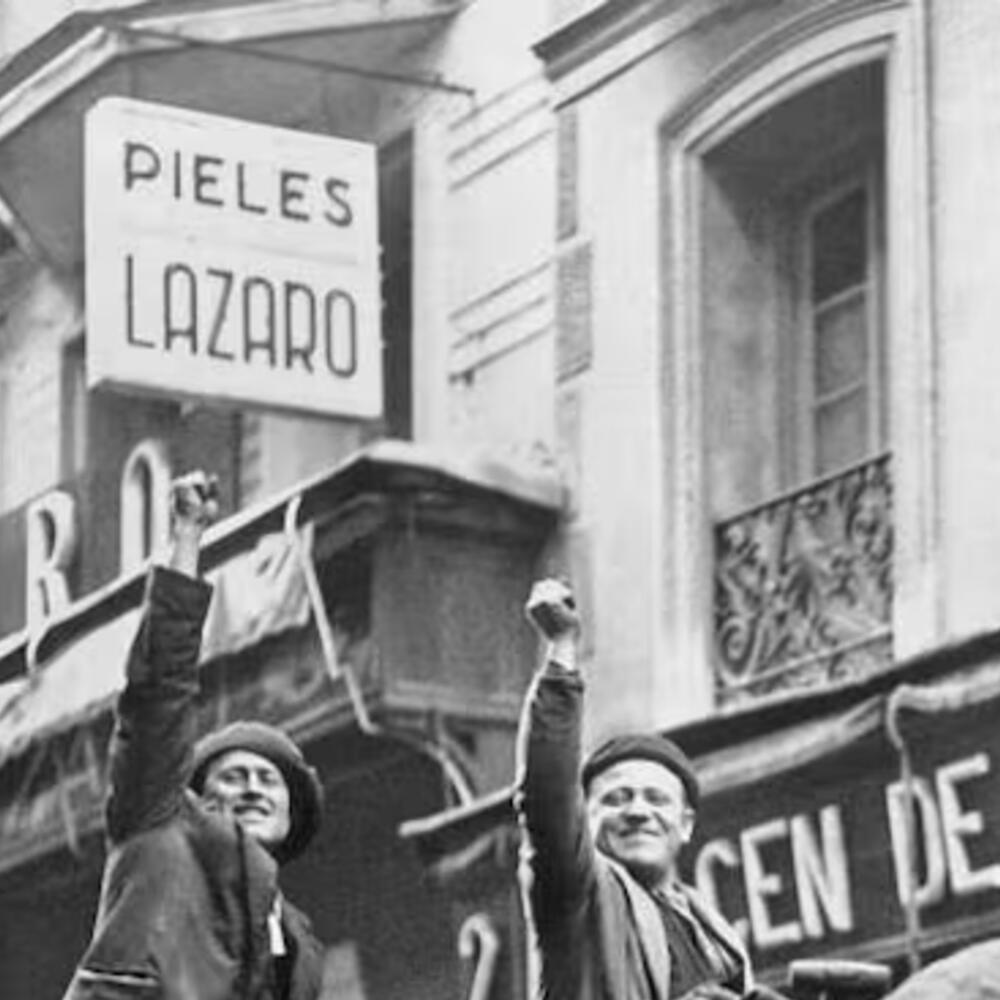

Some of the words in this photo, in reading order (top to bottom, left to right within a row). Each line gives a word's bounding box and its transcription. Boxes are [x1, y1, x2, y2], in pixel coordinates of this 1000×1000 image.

[123, 141, 354, 229] PIELES
[125, 253, 359, 379] LAZARO
[695, 804, 853, 949] CEN
